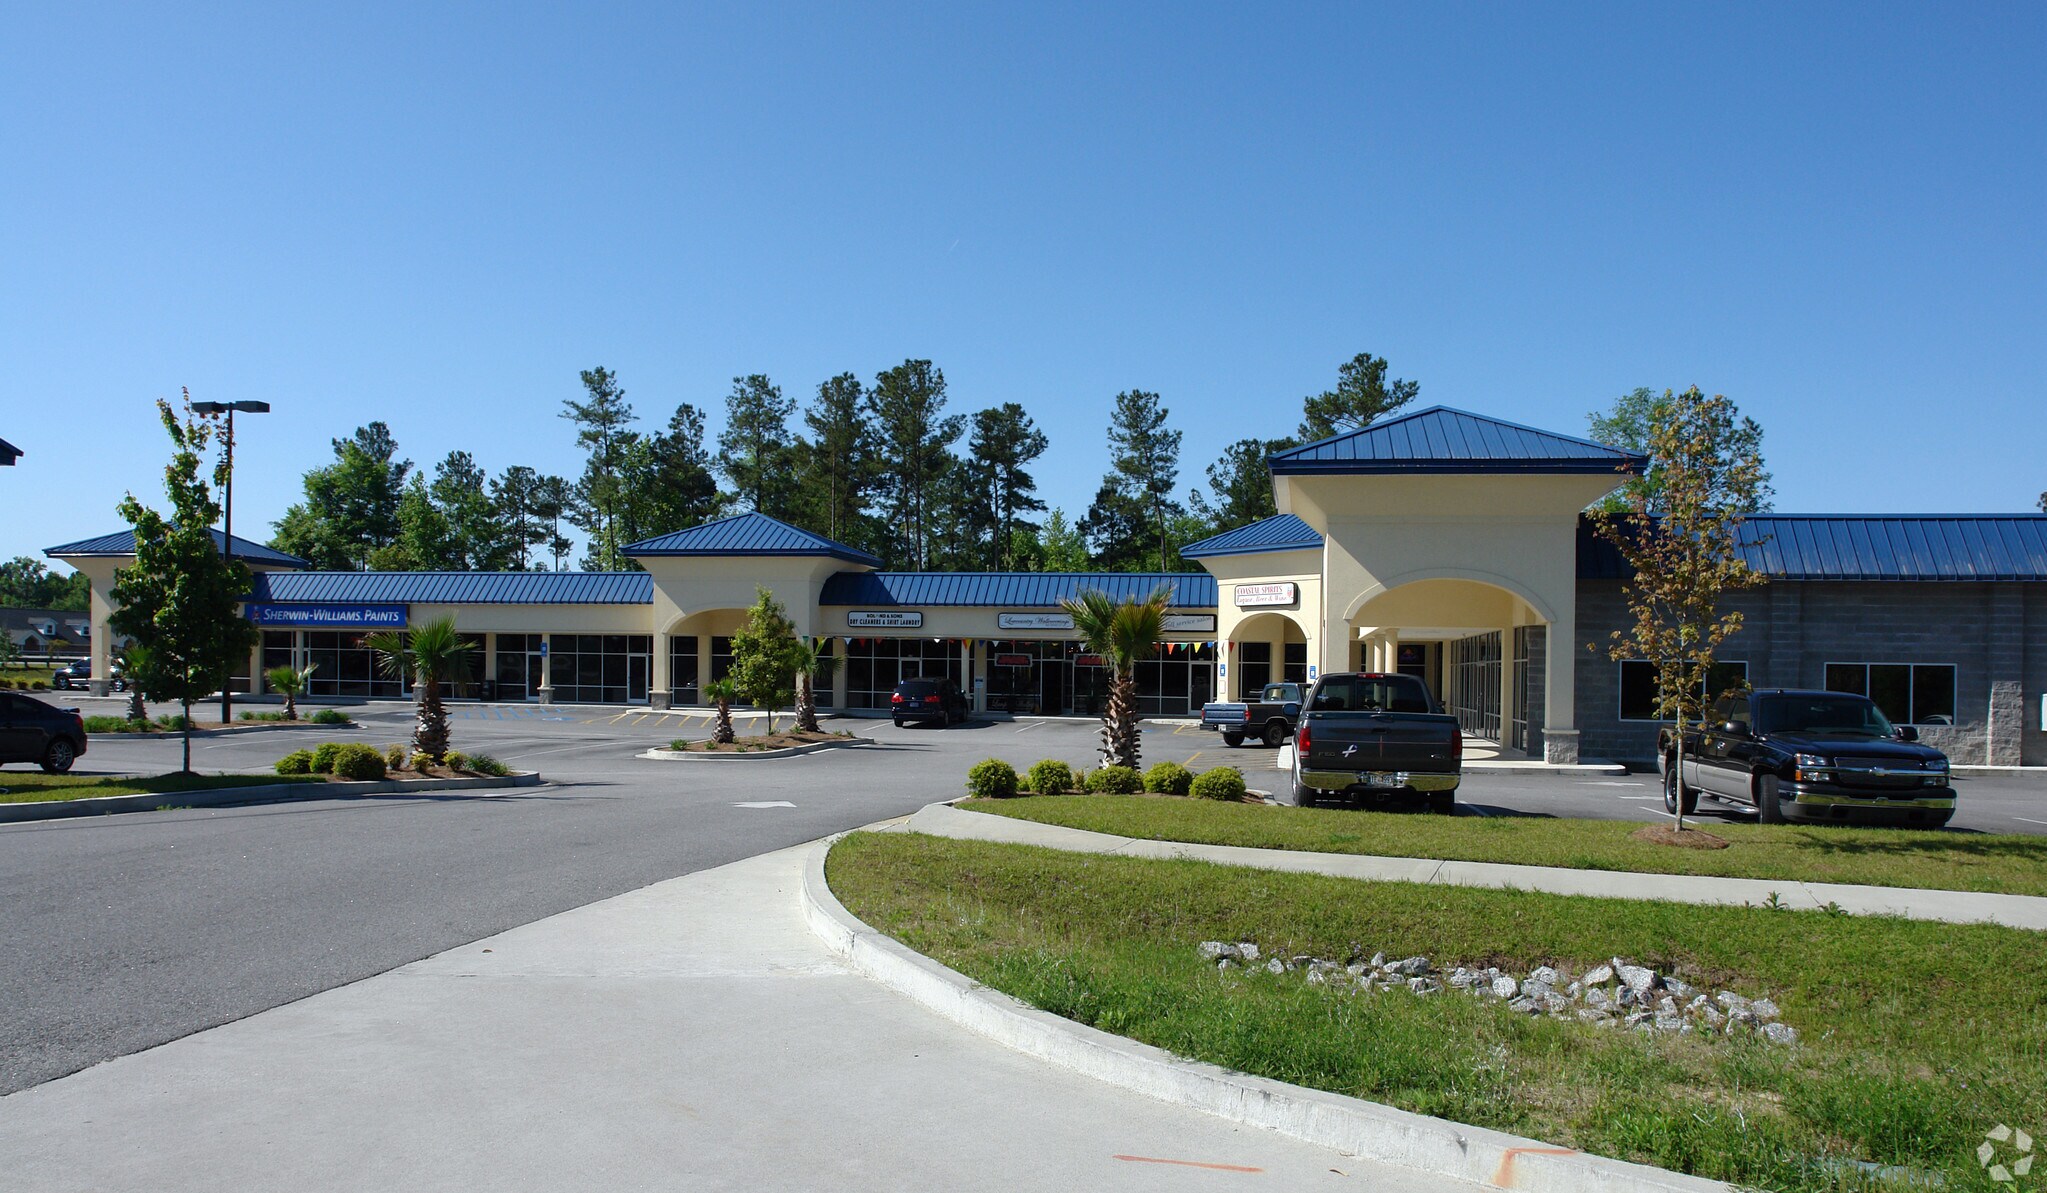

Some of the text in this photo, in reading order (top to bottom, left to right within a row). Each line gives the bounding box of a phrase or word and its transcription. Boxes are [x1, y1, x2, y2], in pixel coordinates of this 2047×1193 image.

[1237, 585, 1283, 595] COASTAL SPIRITS
[263, 608, 399, 622] SHERWIN-WILLIAMS PAINTS
[1176, 618, 1195, 627] service
[1197, 615, 1212, 623] salon
